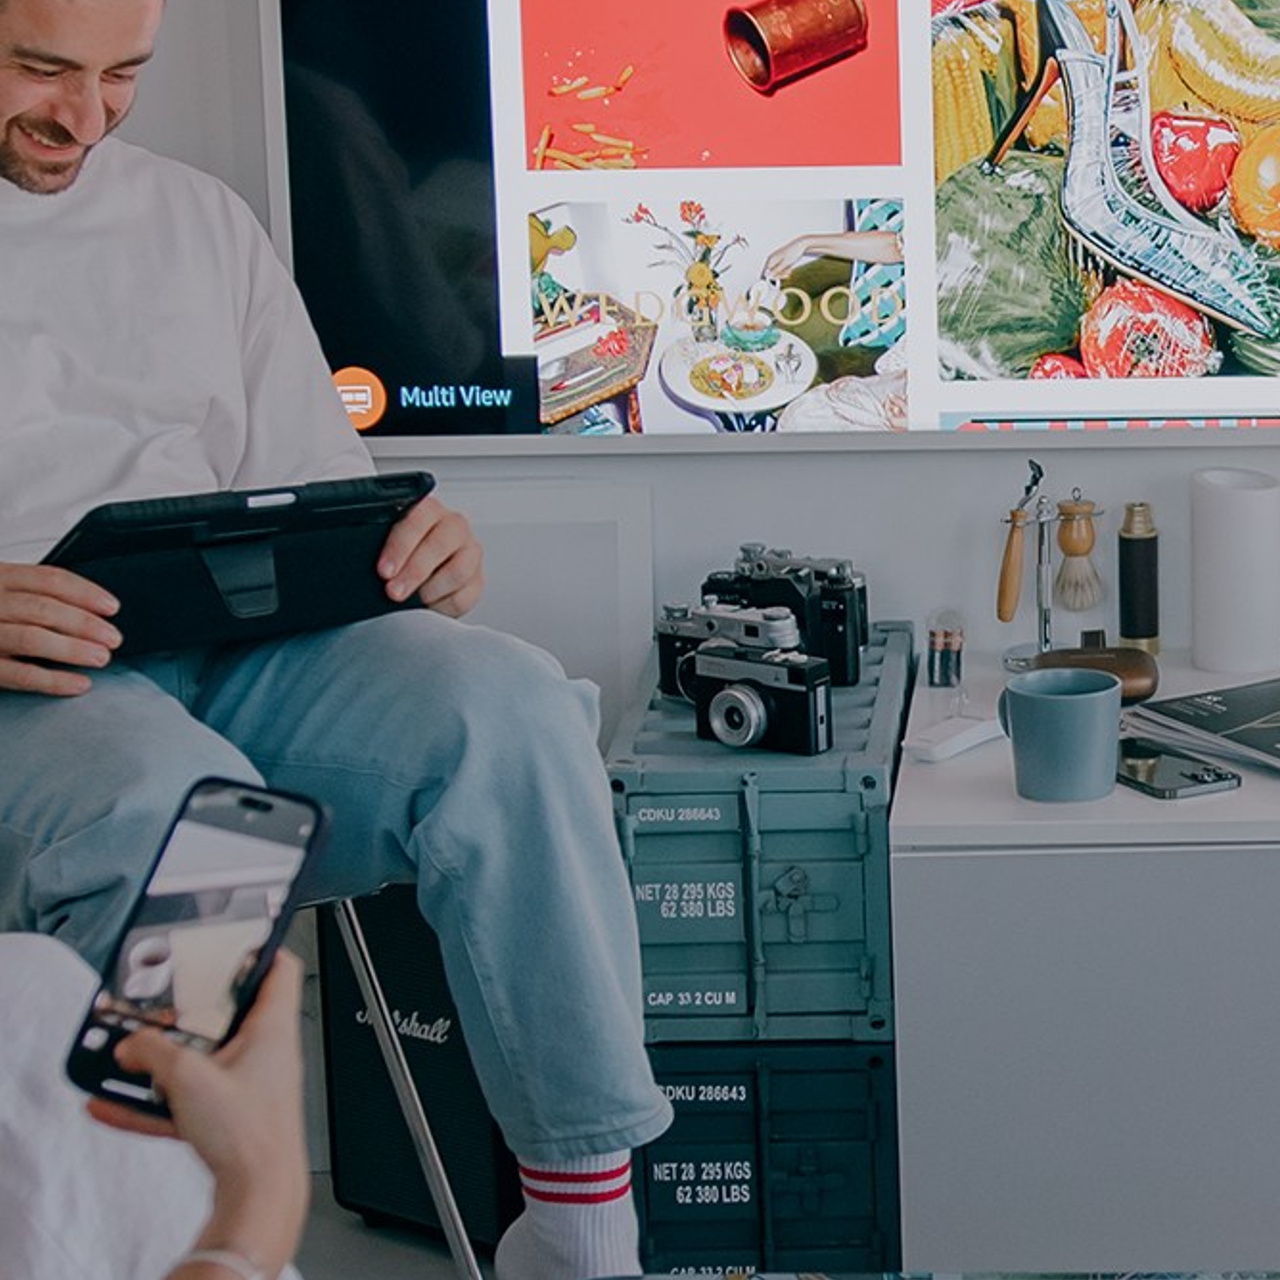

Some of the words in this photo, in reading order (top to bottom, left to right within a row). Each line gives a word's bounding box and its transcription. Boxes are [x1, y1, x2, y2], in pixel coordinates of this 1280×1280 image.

[538, 286, 903, 331] WEDGWOOD
[400, 385, 456, 408] Multi
[459, 385, 512, 408] View
[637, 807, 675, 822] CDKU
[636, 884, 662, 901] NET
[706, 882, 735, 900] KGS
[661, 901, 677, 918] 62
[707, 900, 736, 917] LBS
[648, 991, 673, 1006] CAP
[704, 991, 722, 1005] CU
[725, 990, 737, 1005] M
[356, 1008, 450, 1045] shall
[699, 1085, 747, 1101] 286643
[653, 1163, 679, 1181] NET
[681, 1163, 697, 1181] 28
[700, 1162, 723, 1181] 295
[724, 1161, 751, 1180] KGS
[676, 1186, 693, 1204] 62
[695, 1185, 719, 1203] 380
[722, 1185, 750, 1202] LBS
